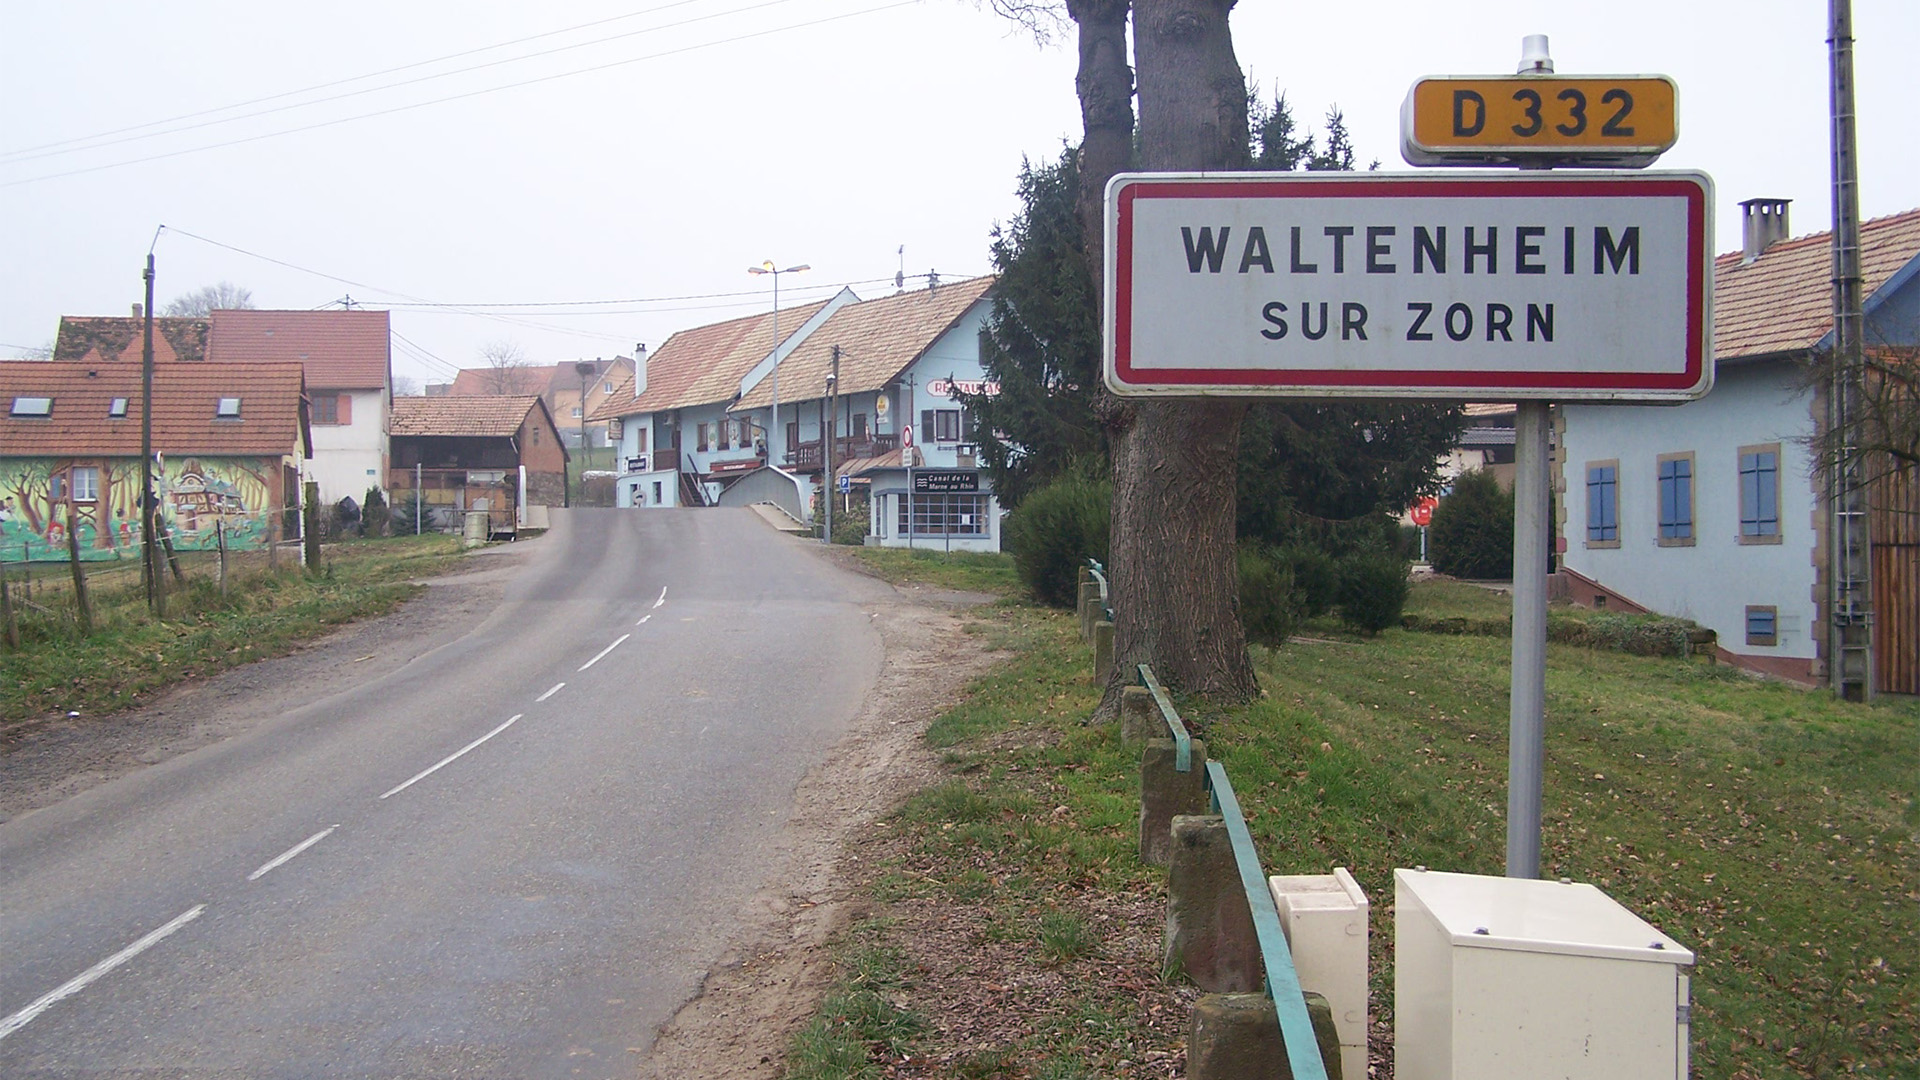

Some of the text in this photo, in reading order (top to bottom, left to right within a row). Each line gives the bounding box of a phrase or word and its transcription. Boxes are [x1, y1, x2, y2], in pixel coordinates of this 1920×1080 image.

[1454, 88, 1635, 138] D 332
[1180, 226, 1641, 275] WALTENHEIM
[1260, 301, 1555, 343] SUR ZORN
[842, 478, 848, 487] P
[962, 474, 970, 482] la
